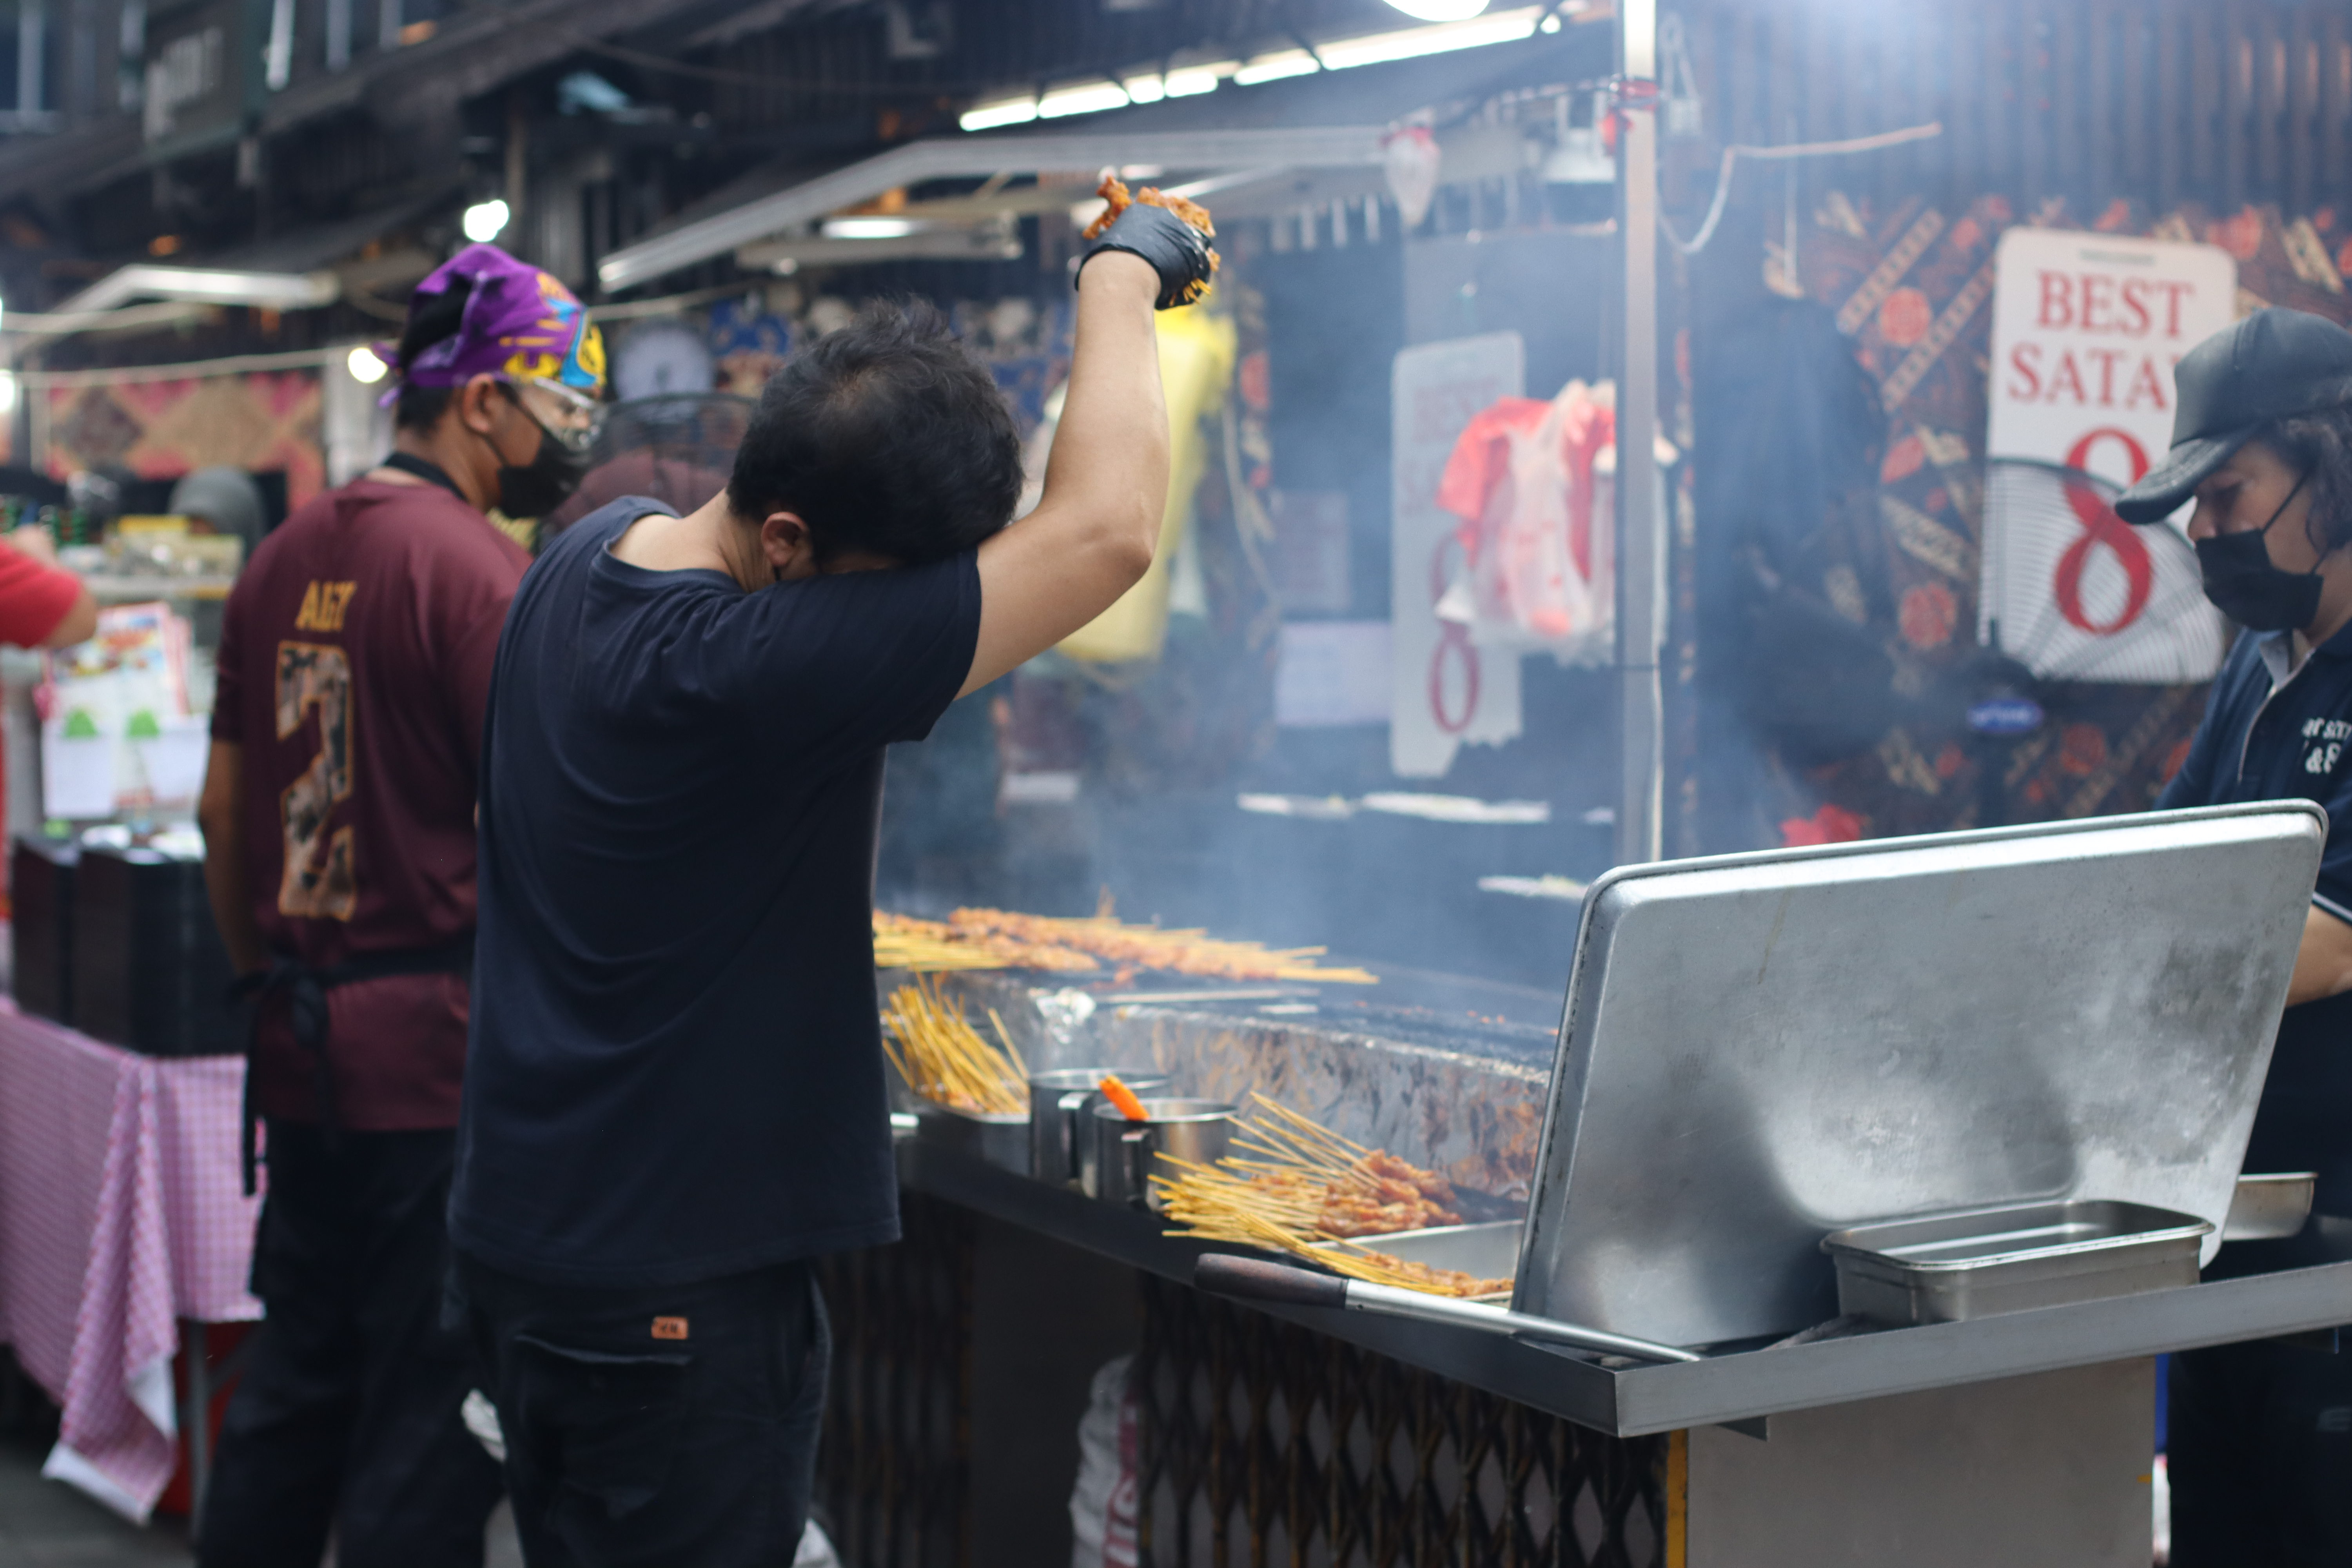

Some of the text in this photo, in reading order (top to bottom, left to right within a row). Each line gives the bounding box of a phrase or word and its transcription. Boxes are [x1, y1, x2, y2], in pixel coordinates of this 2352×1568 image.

[2037, 270, 2197, 339] BEST
[2007, 341, 2180, 413] SATA
[2054, 424, 2152, 637] 8
[275, 640, 358, 922] 2
